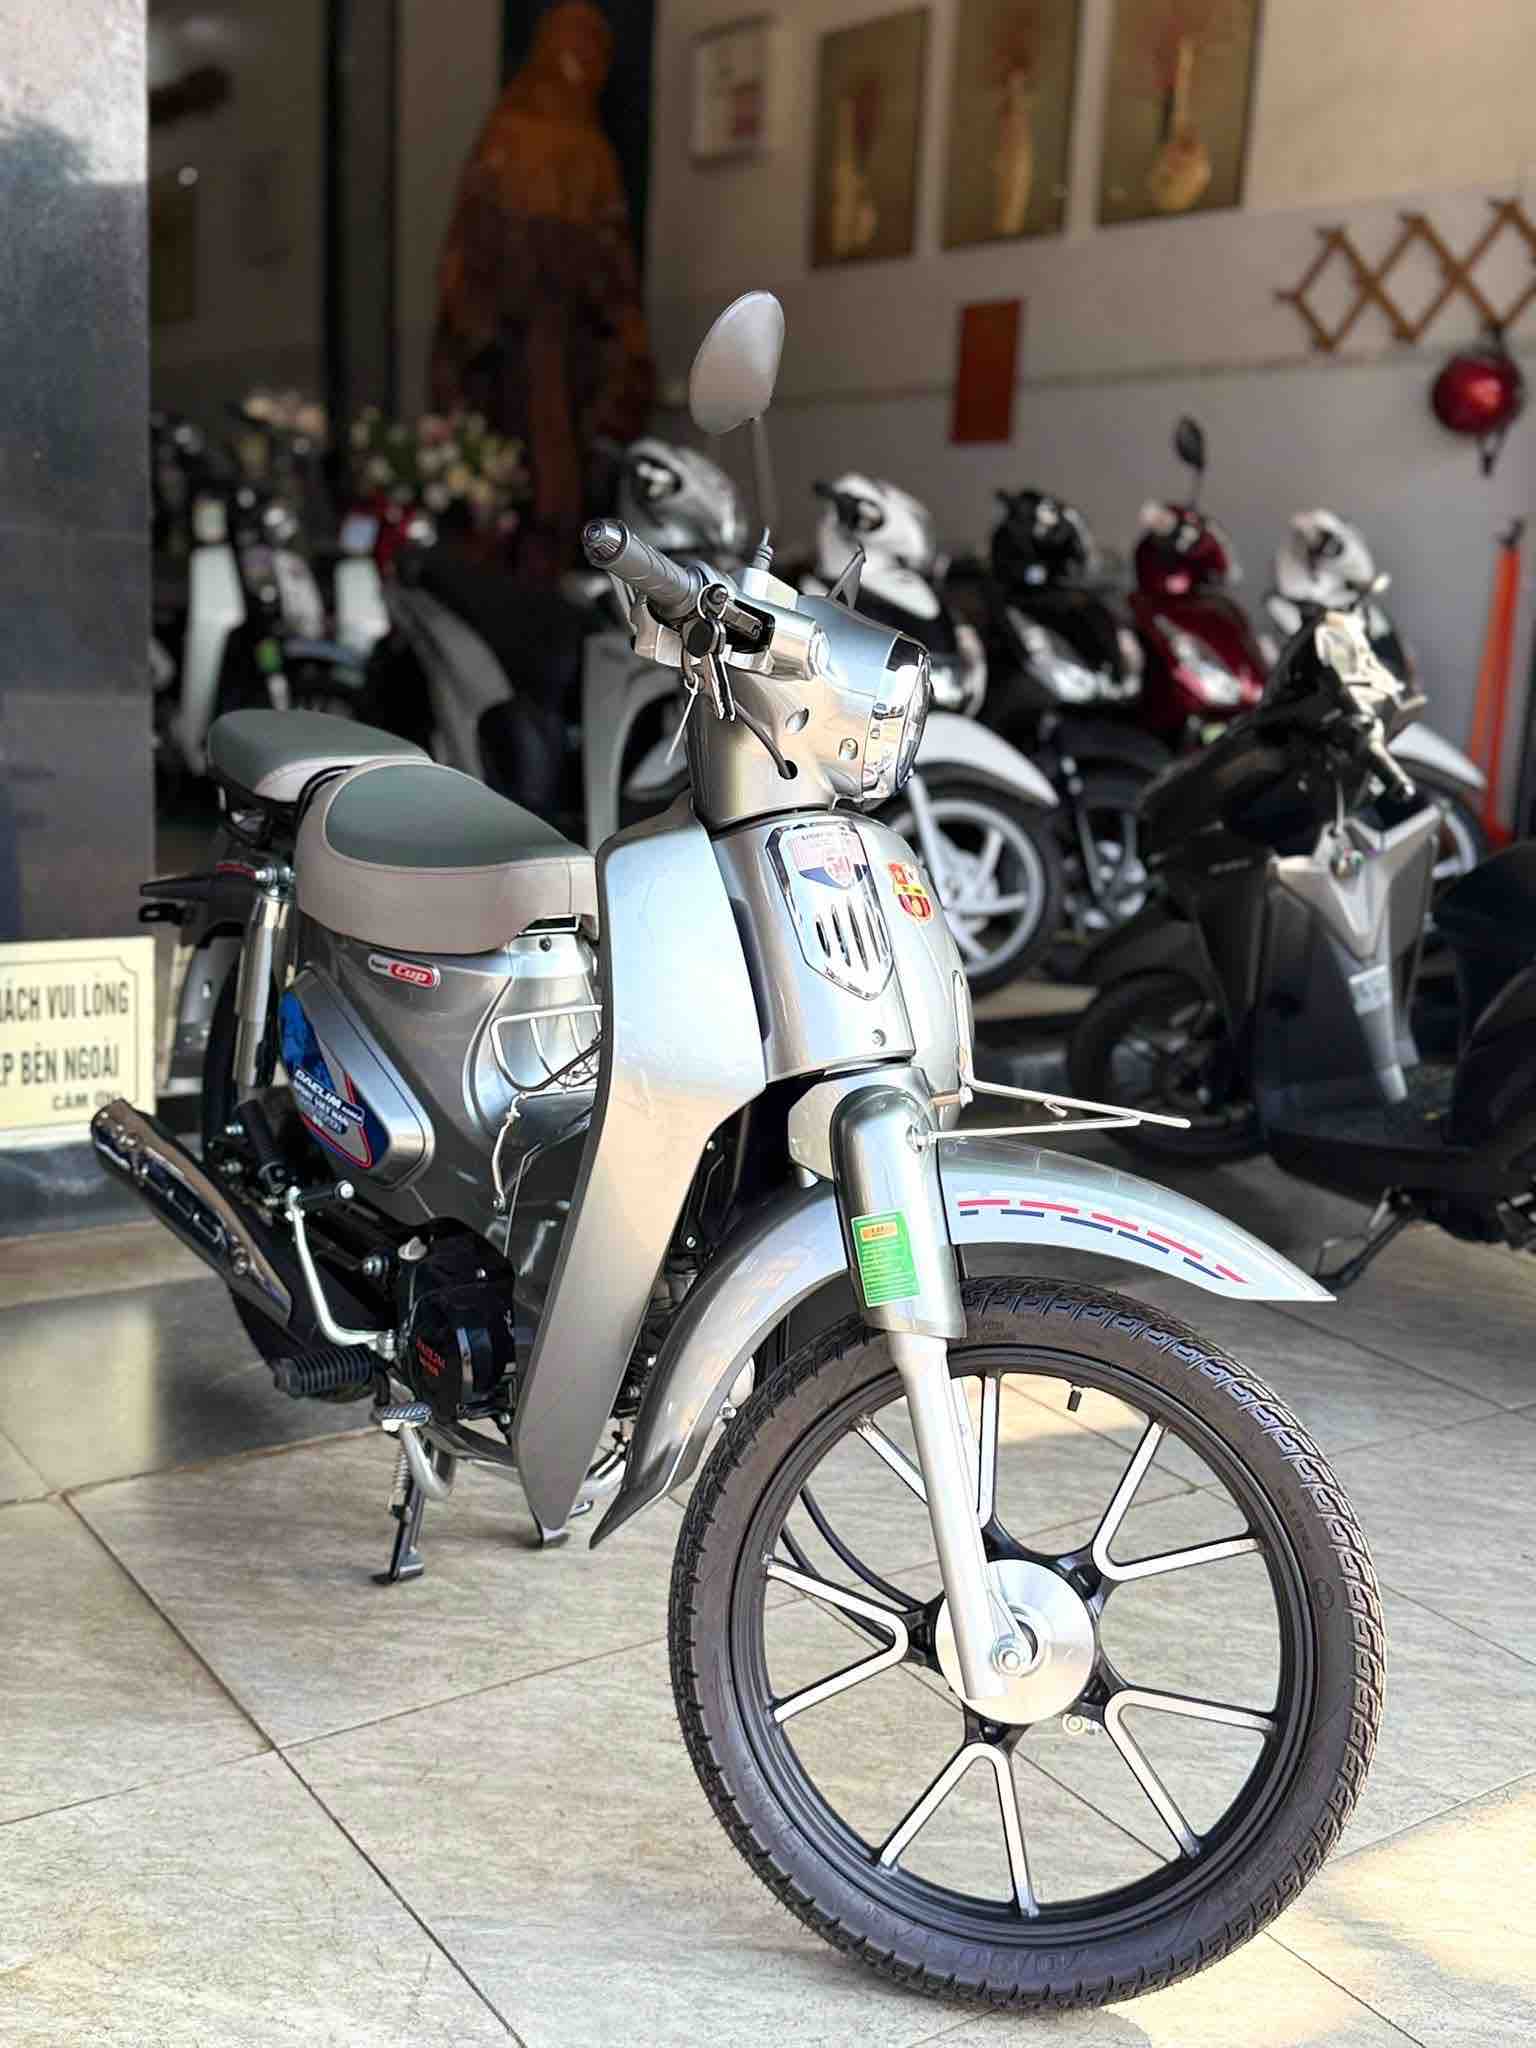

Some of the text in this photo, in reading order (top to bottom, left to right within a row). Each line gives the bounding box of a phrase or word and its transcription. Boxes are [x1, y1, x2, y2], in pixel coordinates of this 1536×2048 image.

[0, 972, 129, 1022] ÁCH VUI LÒNG
[21, 1041, 57, 1086] BÊN
[64, 1036, 119, 1081] NGOÀI
